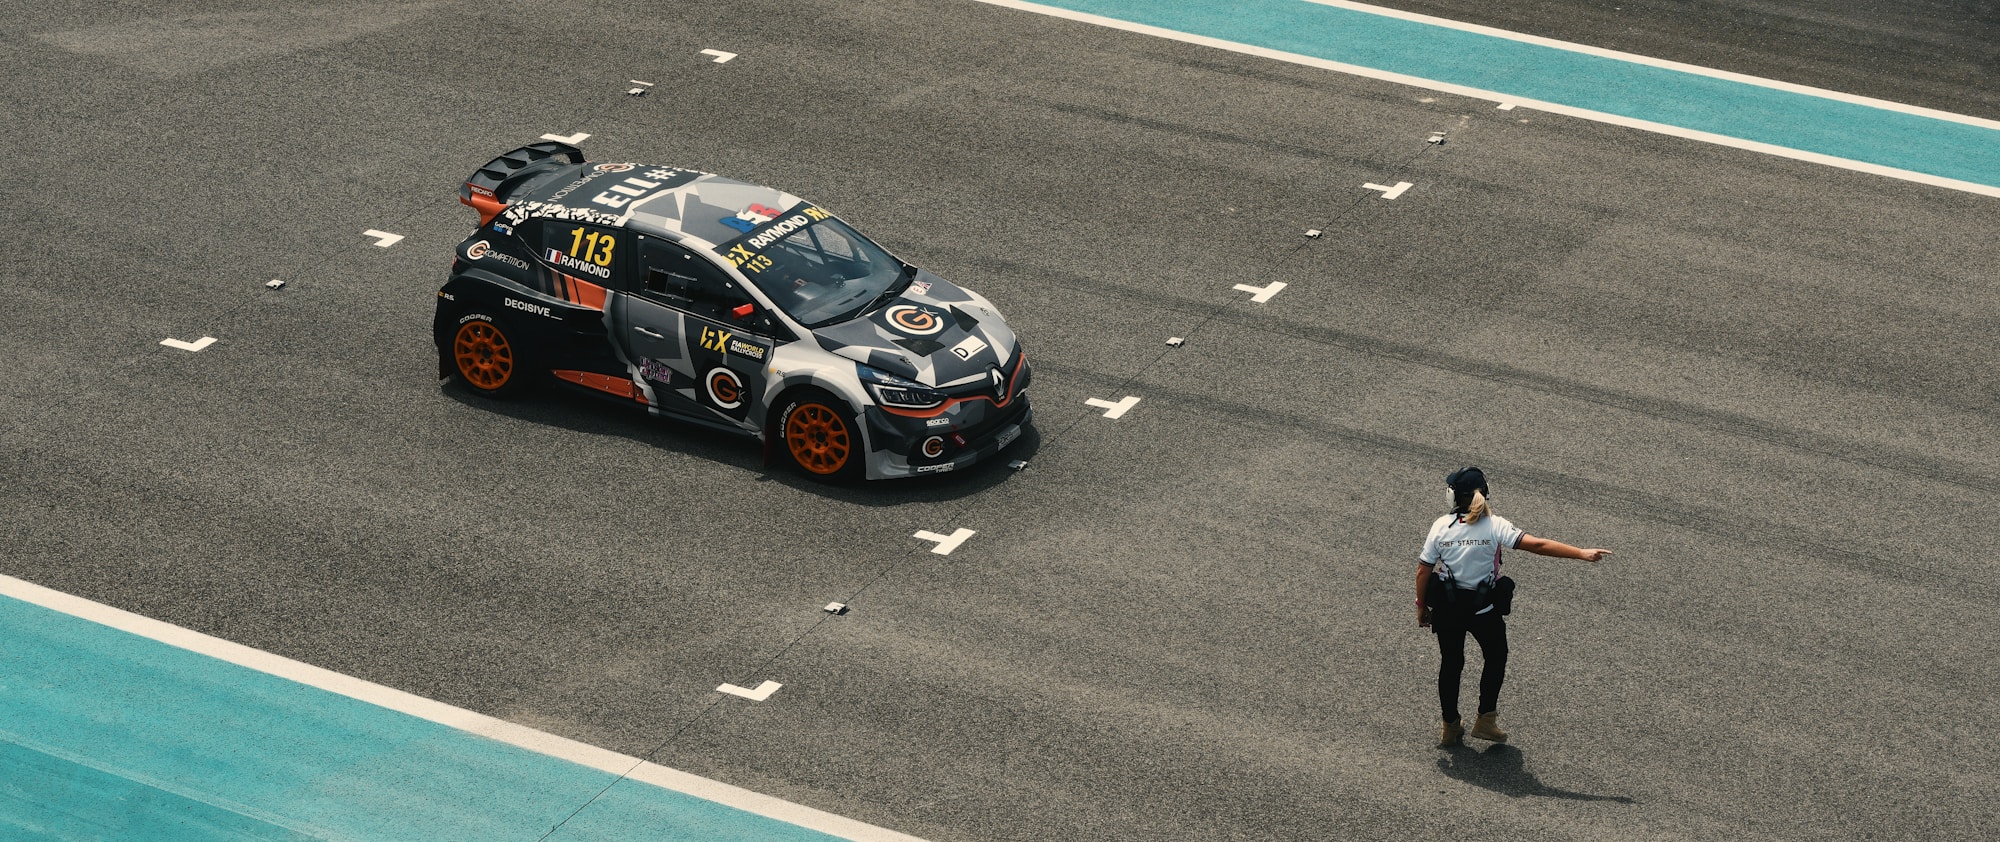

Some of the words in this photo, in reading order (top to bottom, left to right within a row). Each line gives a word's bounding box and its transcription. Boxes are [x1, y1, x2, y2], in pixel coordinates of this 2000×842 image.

[471, 186, 493, 197] RECARO
[748, 215, 809, 249] RAYMOND
[569, 226, 616, 267] 113
[560, 254, 611, 279] RAYMOND
[746, 254, 773, 273] 113
[459, 313, 492, 324] COOPER
[729, 345, 763, 360] RALLYCROSS
[779, 401, 797, 438] COOPER
[917, 462, 955, 473] COOPER
[1438, 540, 1455, 548] CHIEF
[1457, 539, 1492, 547] STARTLINE
